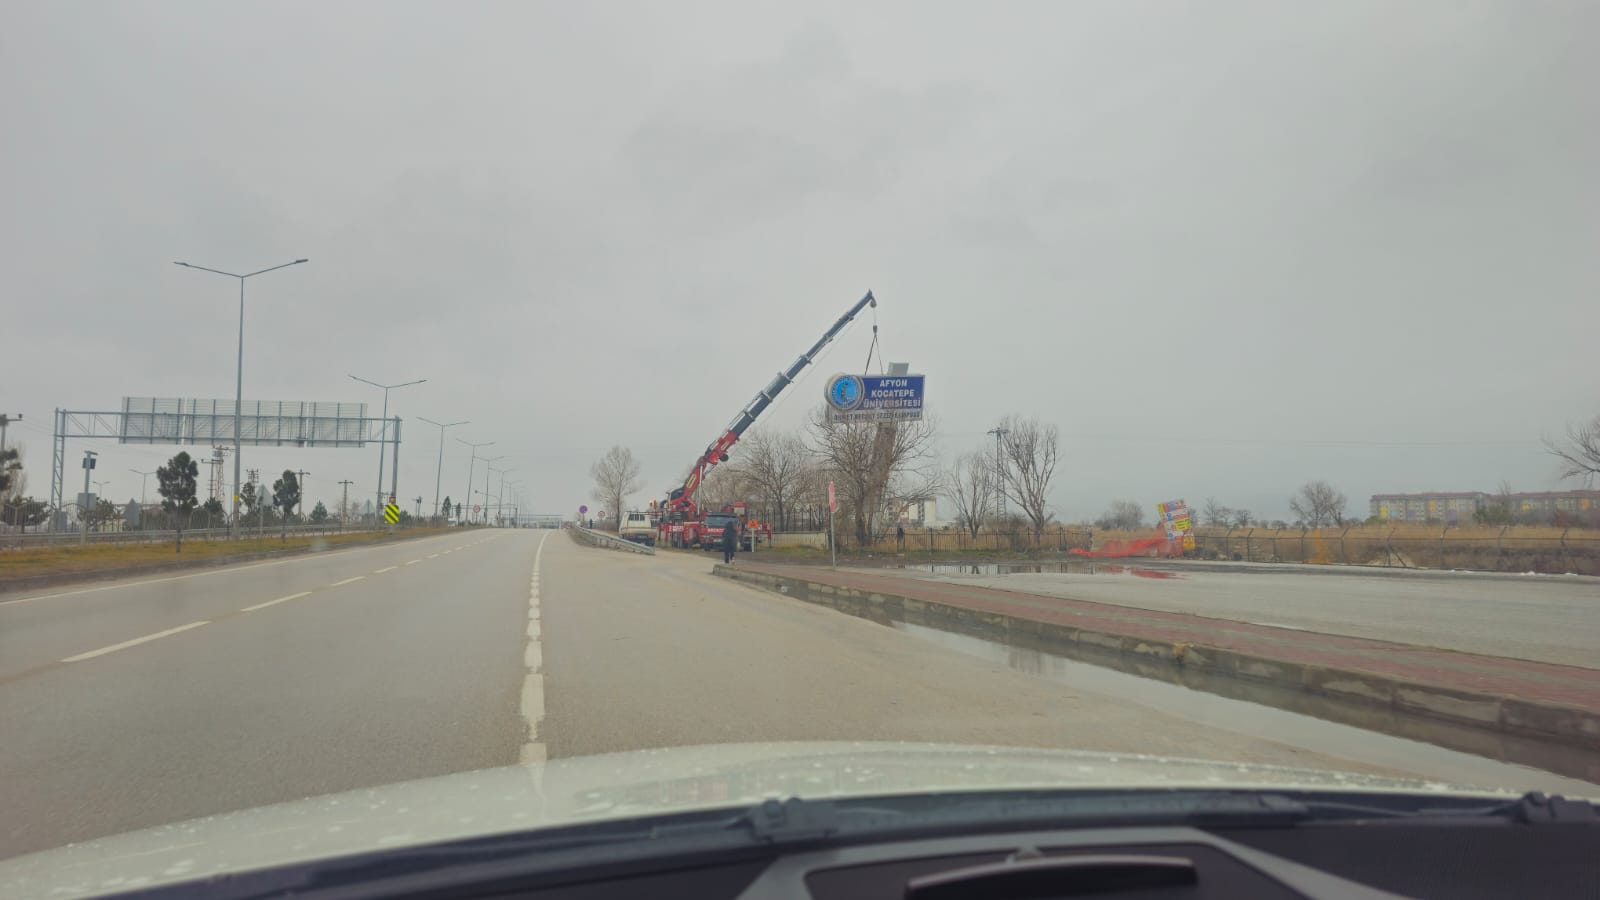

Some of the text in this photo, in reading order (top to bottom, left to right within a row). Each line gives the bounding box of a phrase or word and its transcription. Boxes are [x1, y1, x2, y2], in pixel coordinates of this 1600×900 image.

[880, 379, 908, 387] AFYON
[871, 389, 915, 397] KOCATEPE
[863, 398, 921, 408] ÜNİVERSİTESİ
